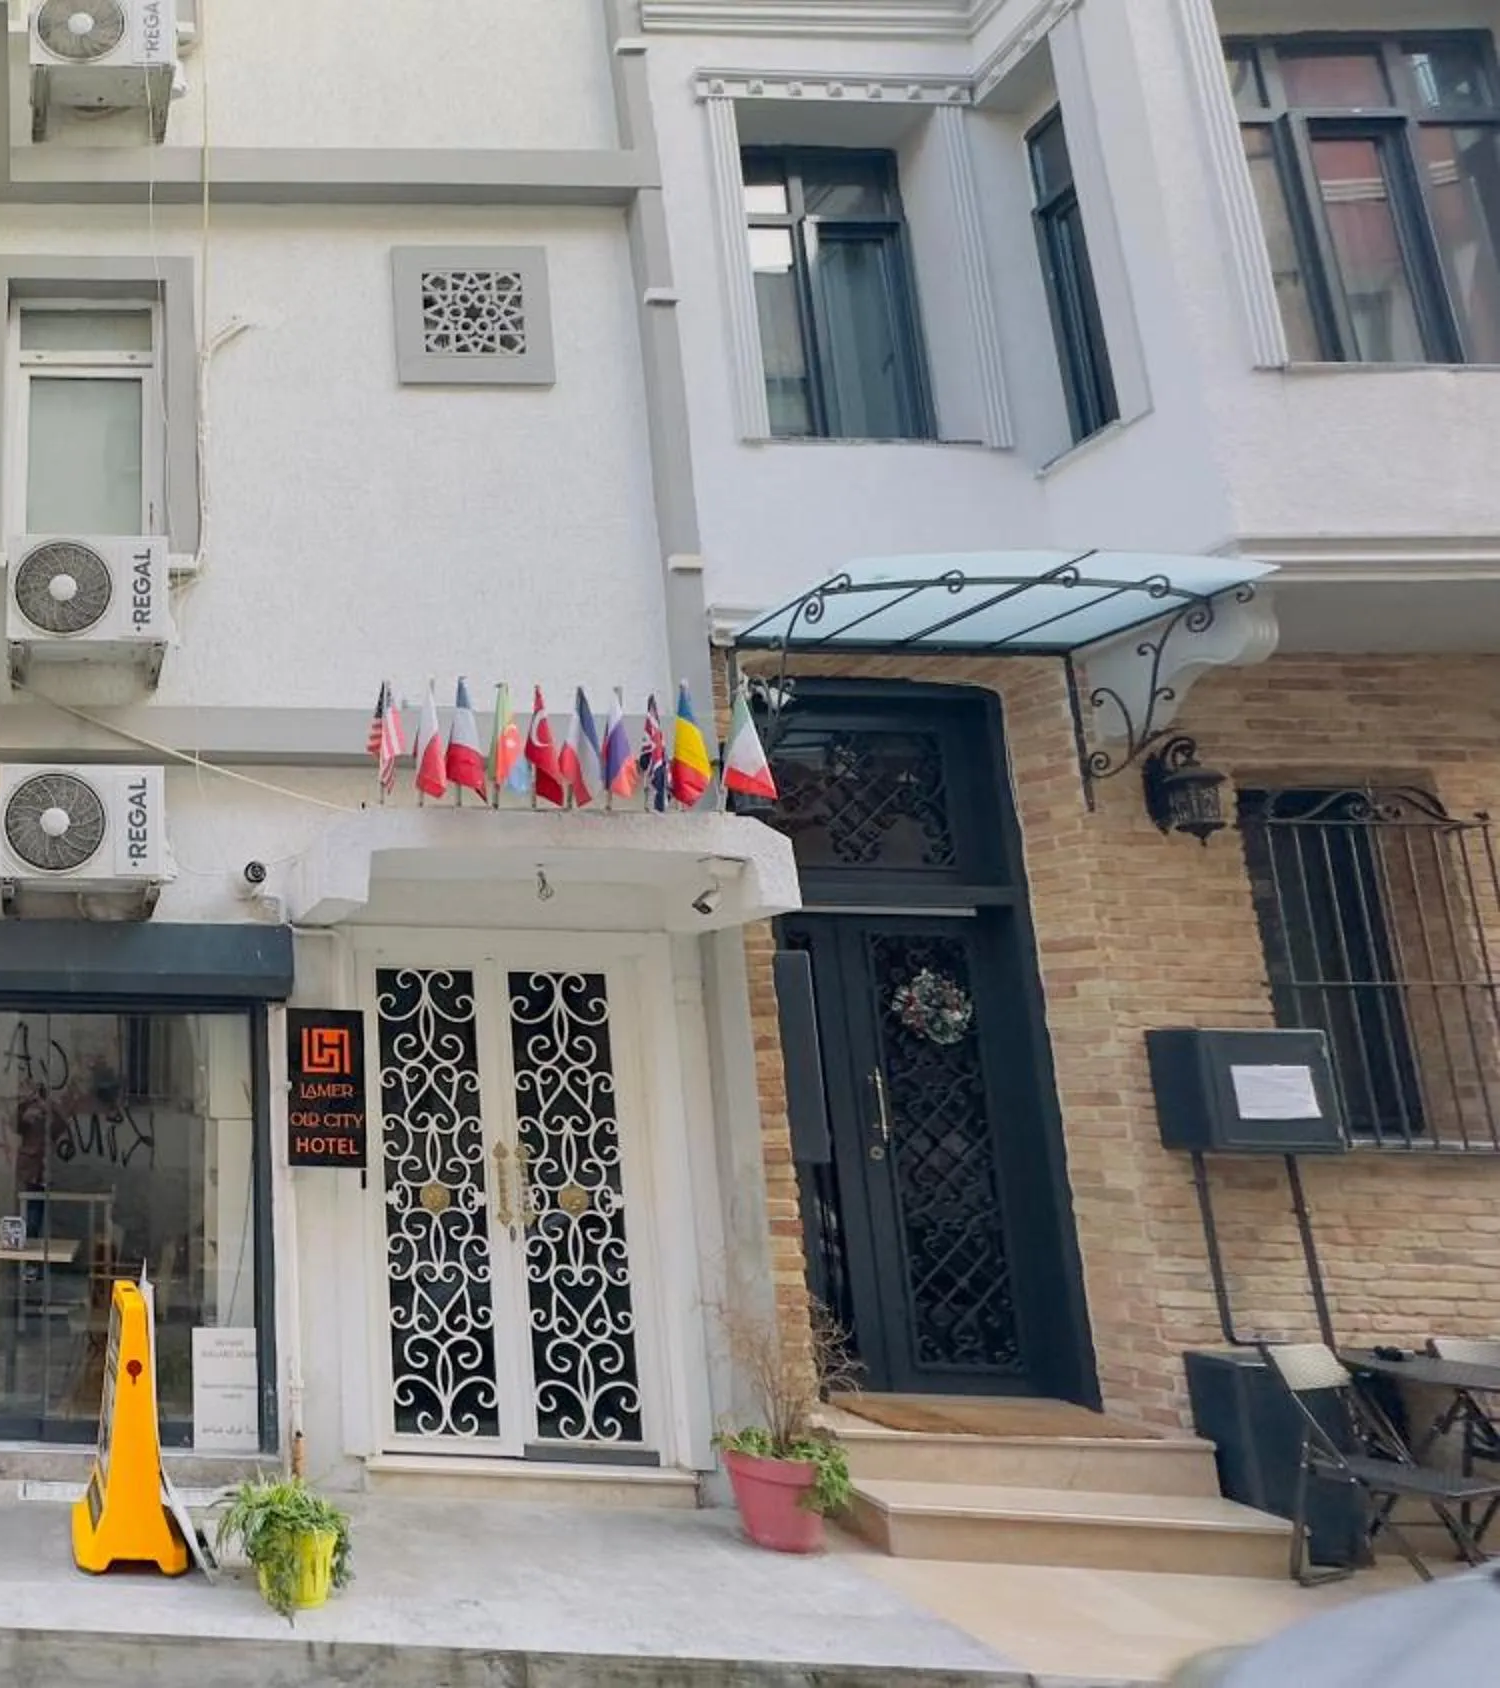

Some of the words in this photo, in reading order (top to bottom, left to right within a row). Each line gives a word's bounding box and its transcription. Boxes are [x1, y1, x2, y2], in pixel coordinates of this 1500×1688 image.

[143, 0, 160, 51] REGA
[133, 548, 151, 624] REGAL
[128, 777, 147, 859] REGAL
[291, 1112, 319, 1127] OLD
[323, 1113, 364, 1128] CITY
[296, 1137, 360, 1154] HOTEL
